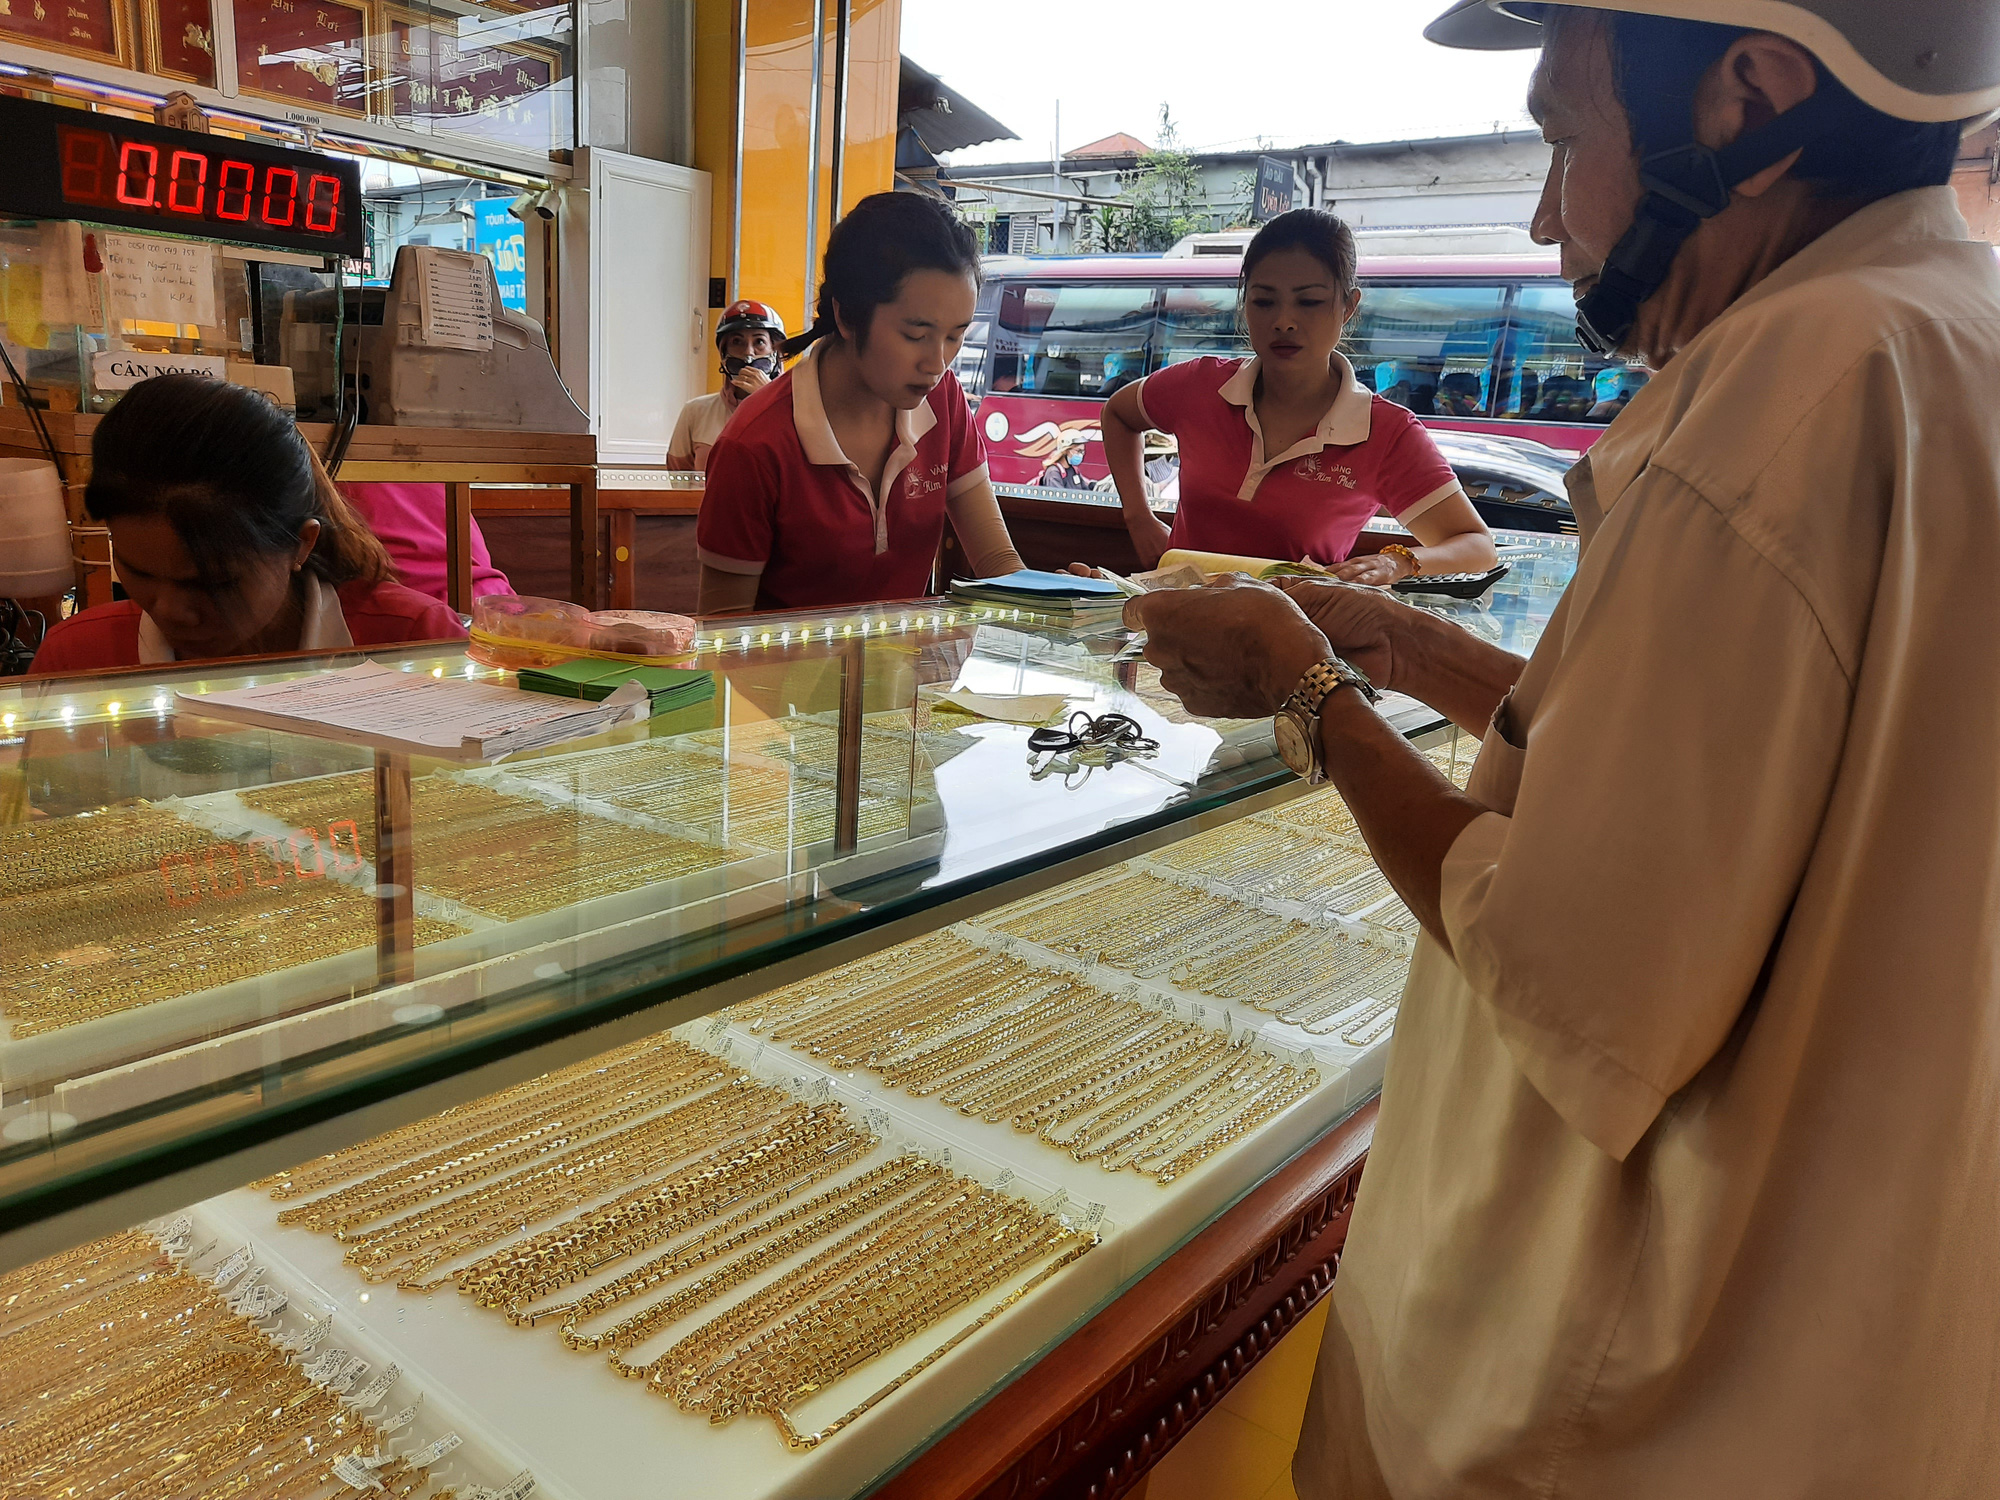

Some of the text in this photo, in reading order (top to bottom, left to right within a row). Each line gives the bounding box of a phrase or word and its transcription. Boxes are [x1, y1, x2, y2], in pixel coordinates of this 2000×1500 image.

[285, 111, 320, 125] 1.000.000
[110, 360, 149, 378] CÂN
[930, 462, 949, 476] VÀN
[1330, 463, 1352, 475] VÀNG
